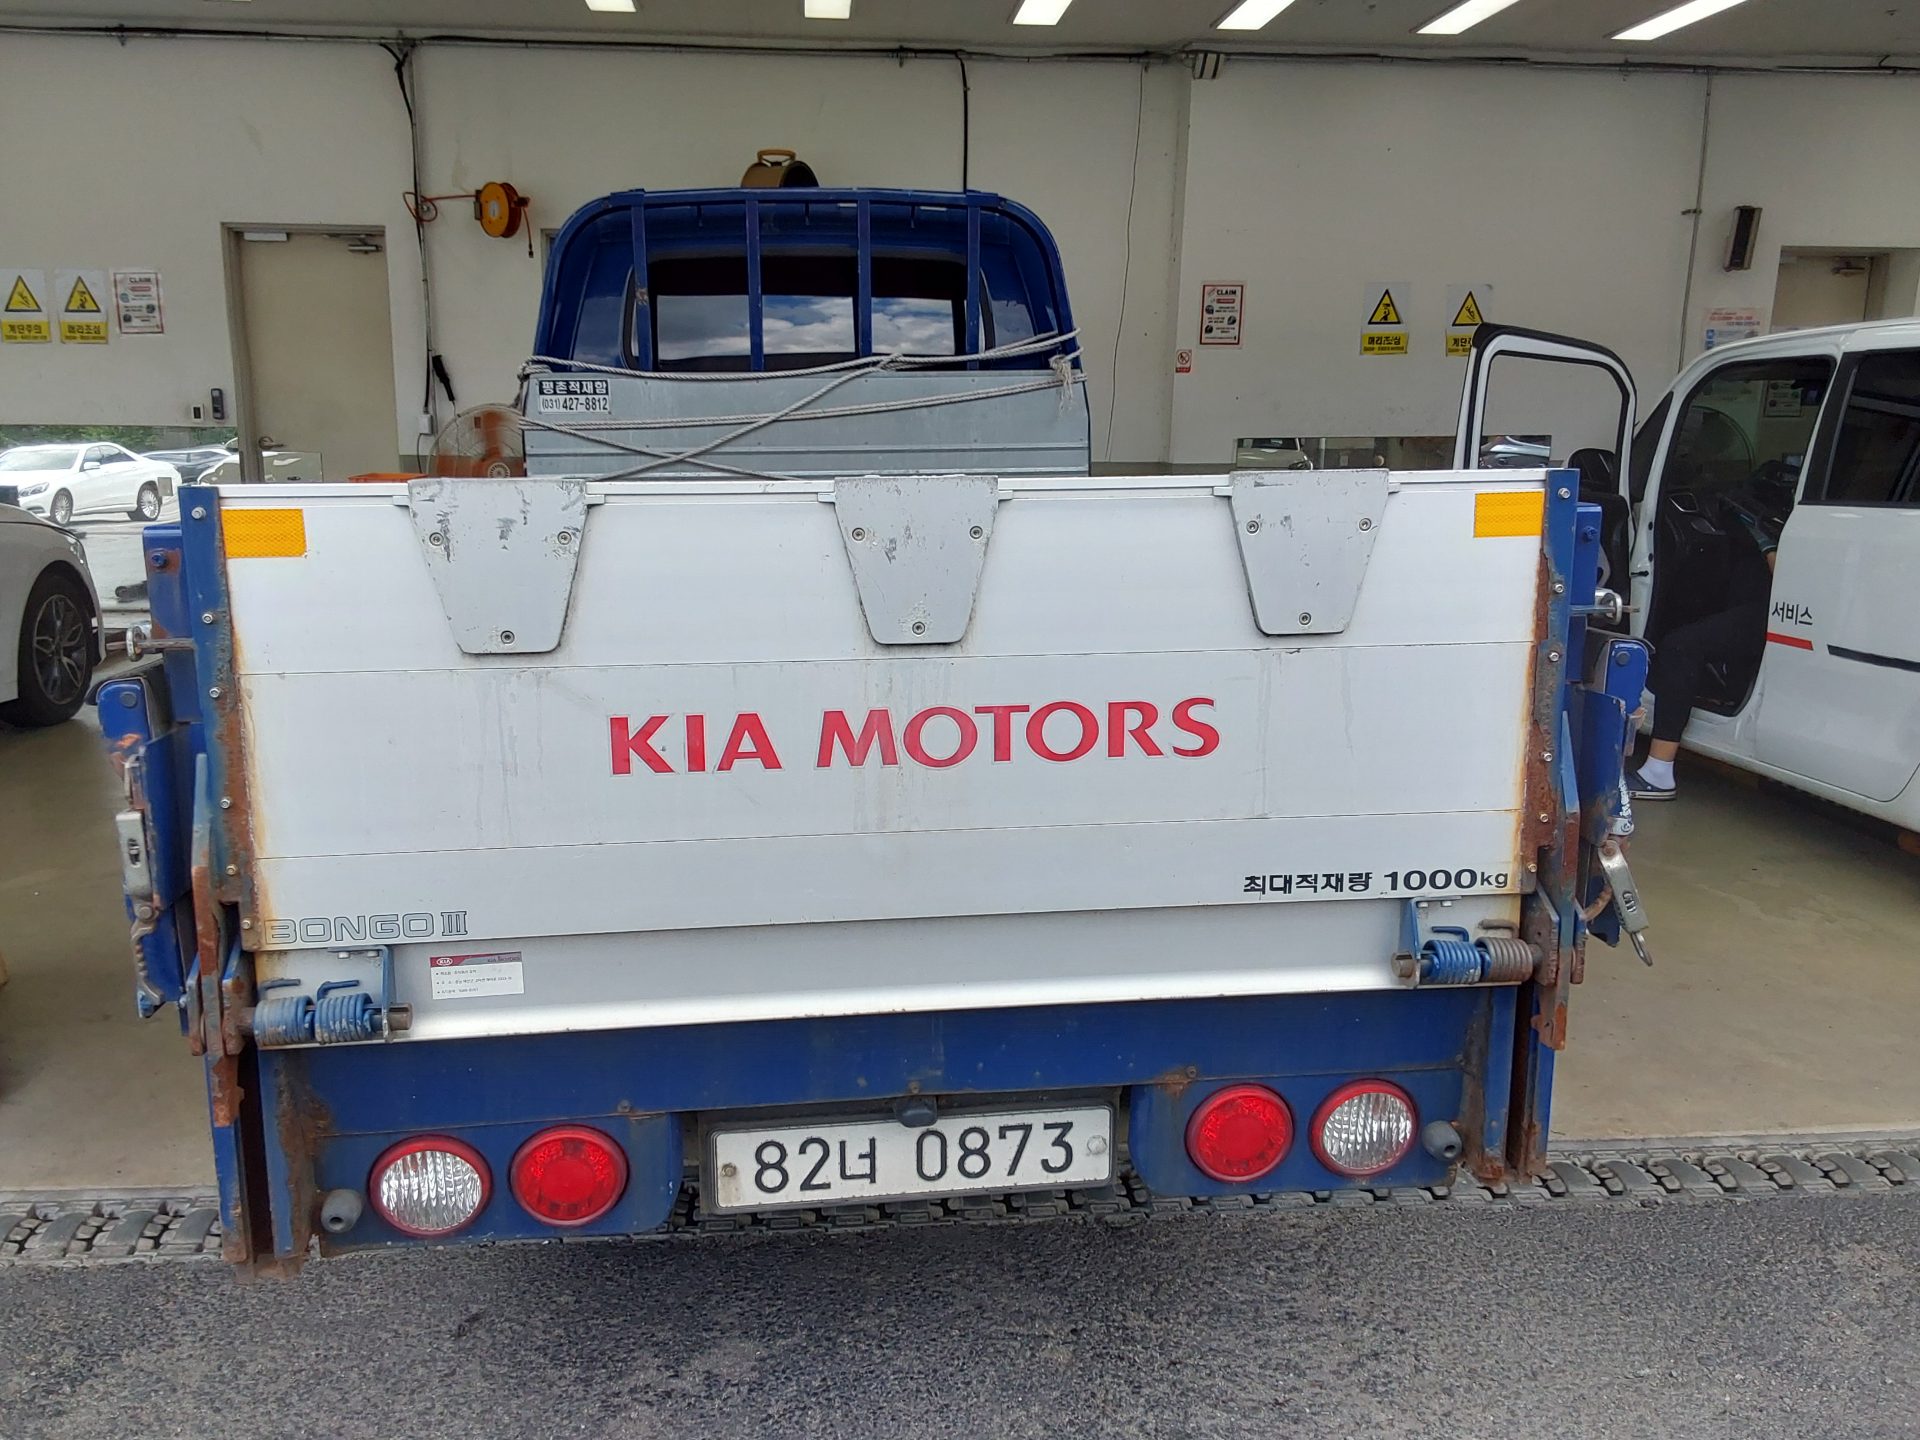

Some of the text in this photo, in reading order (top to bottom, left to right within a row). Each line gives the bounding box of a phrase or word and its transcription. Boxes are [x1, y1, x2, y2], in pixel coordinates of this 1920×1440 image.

[541, 381, 607, 394] 평촌적재함
[562, 397, 608, 410] 427-8812
[1772, 601, 1813, 626] 서비스
[609, 697, 1221, 776] KIA MOTORS
[1243, 868, 1509, 895] 최대적재량 1000kg
[264, 912, 434, 944] BONGO
[753, 1121, 1074, 1194] 82너 0873
